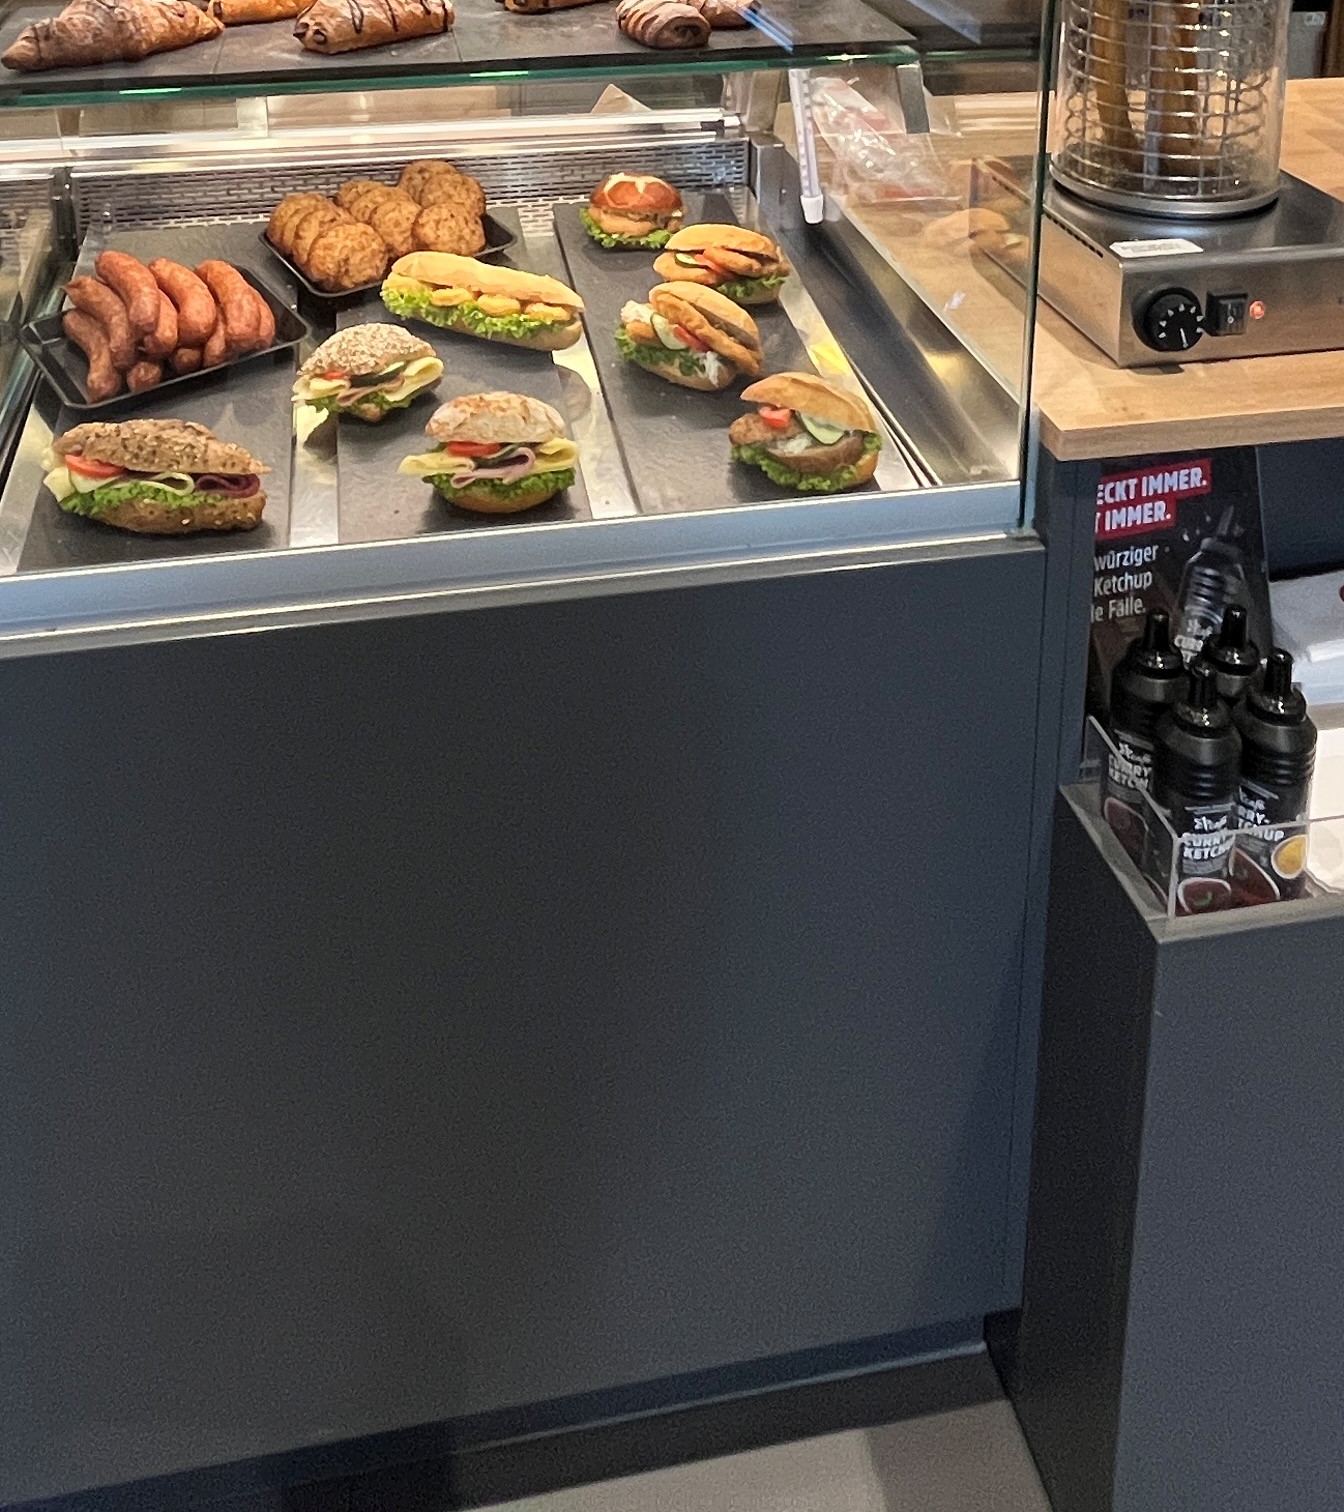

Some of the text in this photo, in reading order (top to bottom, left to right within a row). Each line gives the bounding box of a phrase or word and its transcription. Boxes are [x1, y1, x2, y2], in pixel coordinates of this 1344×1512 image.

[1141, 466, 1208, 497] IMMER.
[1104, 500, 1172, 531] IMMER.
[1093, 570, 1153, 598] Ketchup
